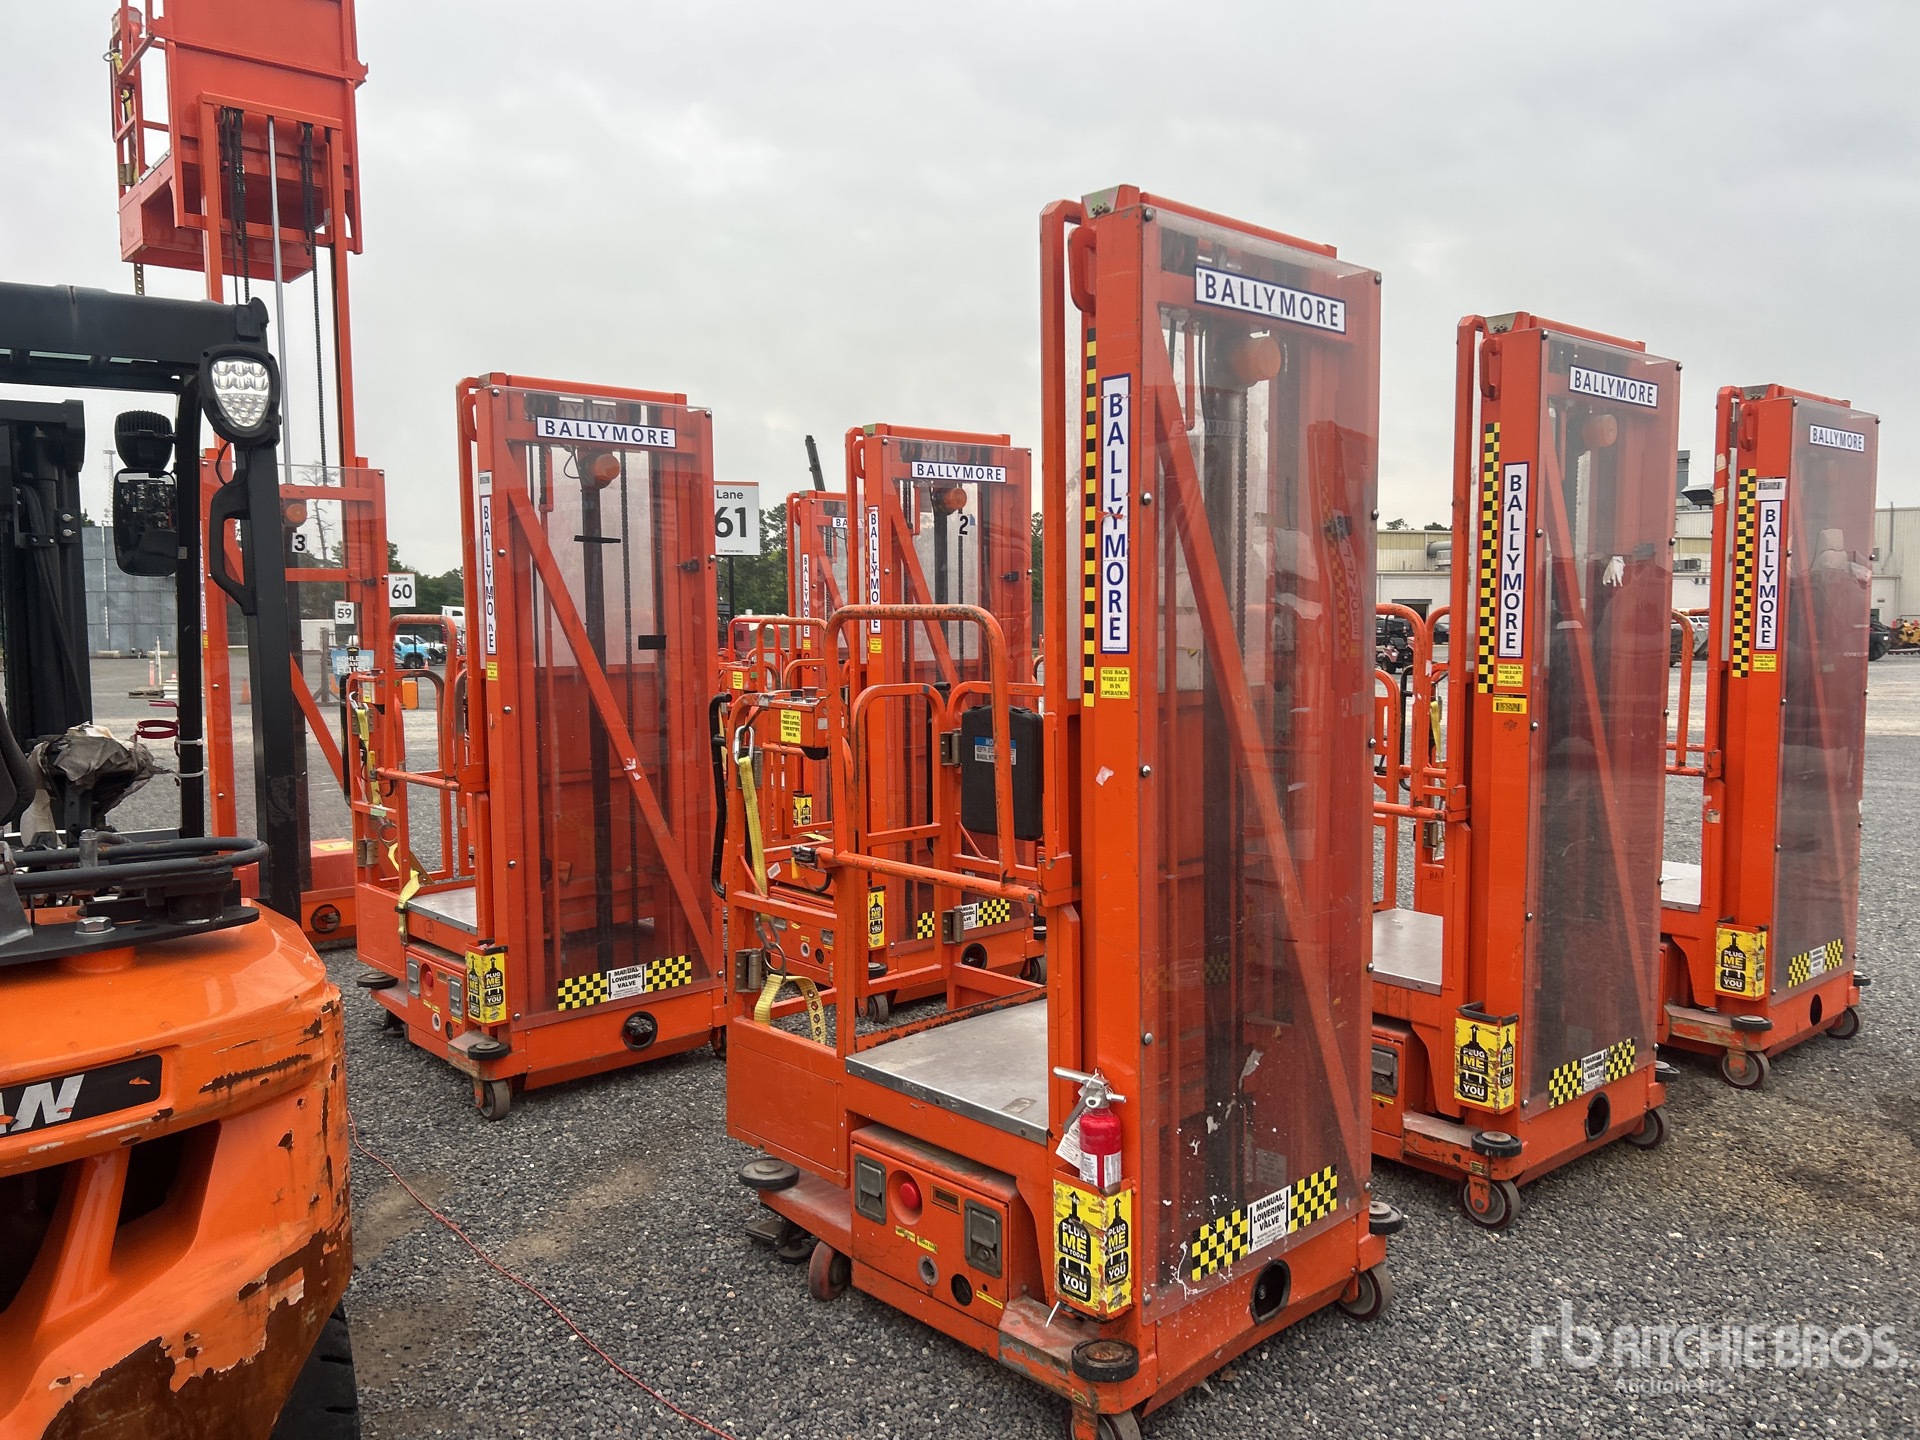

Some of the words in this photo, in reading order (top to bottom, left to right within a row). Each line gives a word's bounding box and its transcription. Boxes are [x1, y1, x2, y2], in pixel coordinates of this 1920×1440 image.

[1204, 273, 1340, 327] BALLYMORE
[1574, 370, 1654, 404] BALLYMORE
[544, 420, 669, 445] BALLYMORE
[1812, 428, 1862, 450] BALLYMORE
[916, 463, 1002, 481] BALLYMORE
[716, 489, 744, 500] Lane
[715, 506, 747, 538] 61
[958, 514, 969, 535] 2
[1104, 393, 1127, 641] BALLYMORE
[294, 534, 306, 551] 3
[1503, 475, 1523, 650] BALLYMORE
[870, 513, 880, 629] BALLYMOE
[1759, 509, 1777, 643] BALLYMORE
[391, 584, 413, 599] 60
[337, 608, 352, 619] 59
[1723, 949, 1744, 958] PLUG
[1724, 955, 1744, 967] ME
[486, 971, 501, 979] PLUG
[486, 976, 501, 986] ME
[612, 972, 641, 983] LOWERING
[1723, 978, 1743, 988] YOU
[617, 980, 636, 988] VALVE
[487, 995, 502, 1004] YOU
[1463, 1047, 1485, 1059] PLUG
[1502, 1051, 1513, 1063] ME
[1463, 1056, 1485, 1070] ME
[1462, 1083, 1485, 1097] YOU
[1256, 1193, 1283, 1212] MANUAL
[1253, 1202, 1285, 1224] LOWERING
[1062, 1221, 1087, 1241] PLUG
[1107, 1223, 1126, 1237] PLUG
[1259, 1215, 1280, 1231] VALVE
[1062, 1231, 1087, 1255] ME
[1108, 1231, 1126, 1249] ME
[1062, 1245, 1069, 1254] IN
[1069, 1249, 1087, 1261] TODAY
[1108, 1264, 1126, 1279] YOU
[1062, 1273, 1088, 1294] YOU
